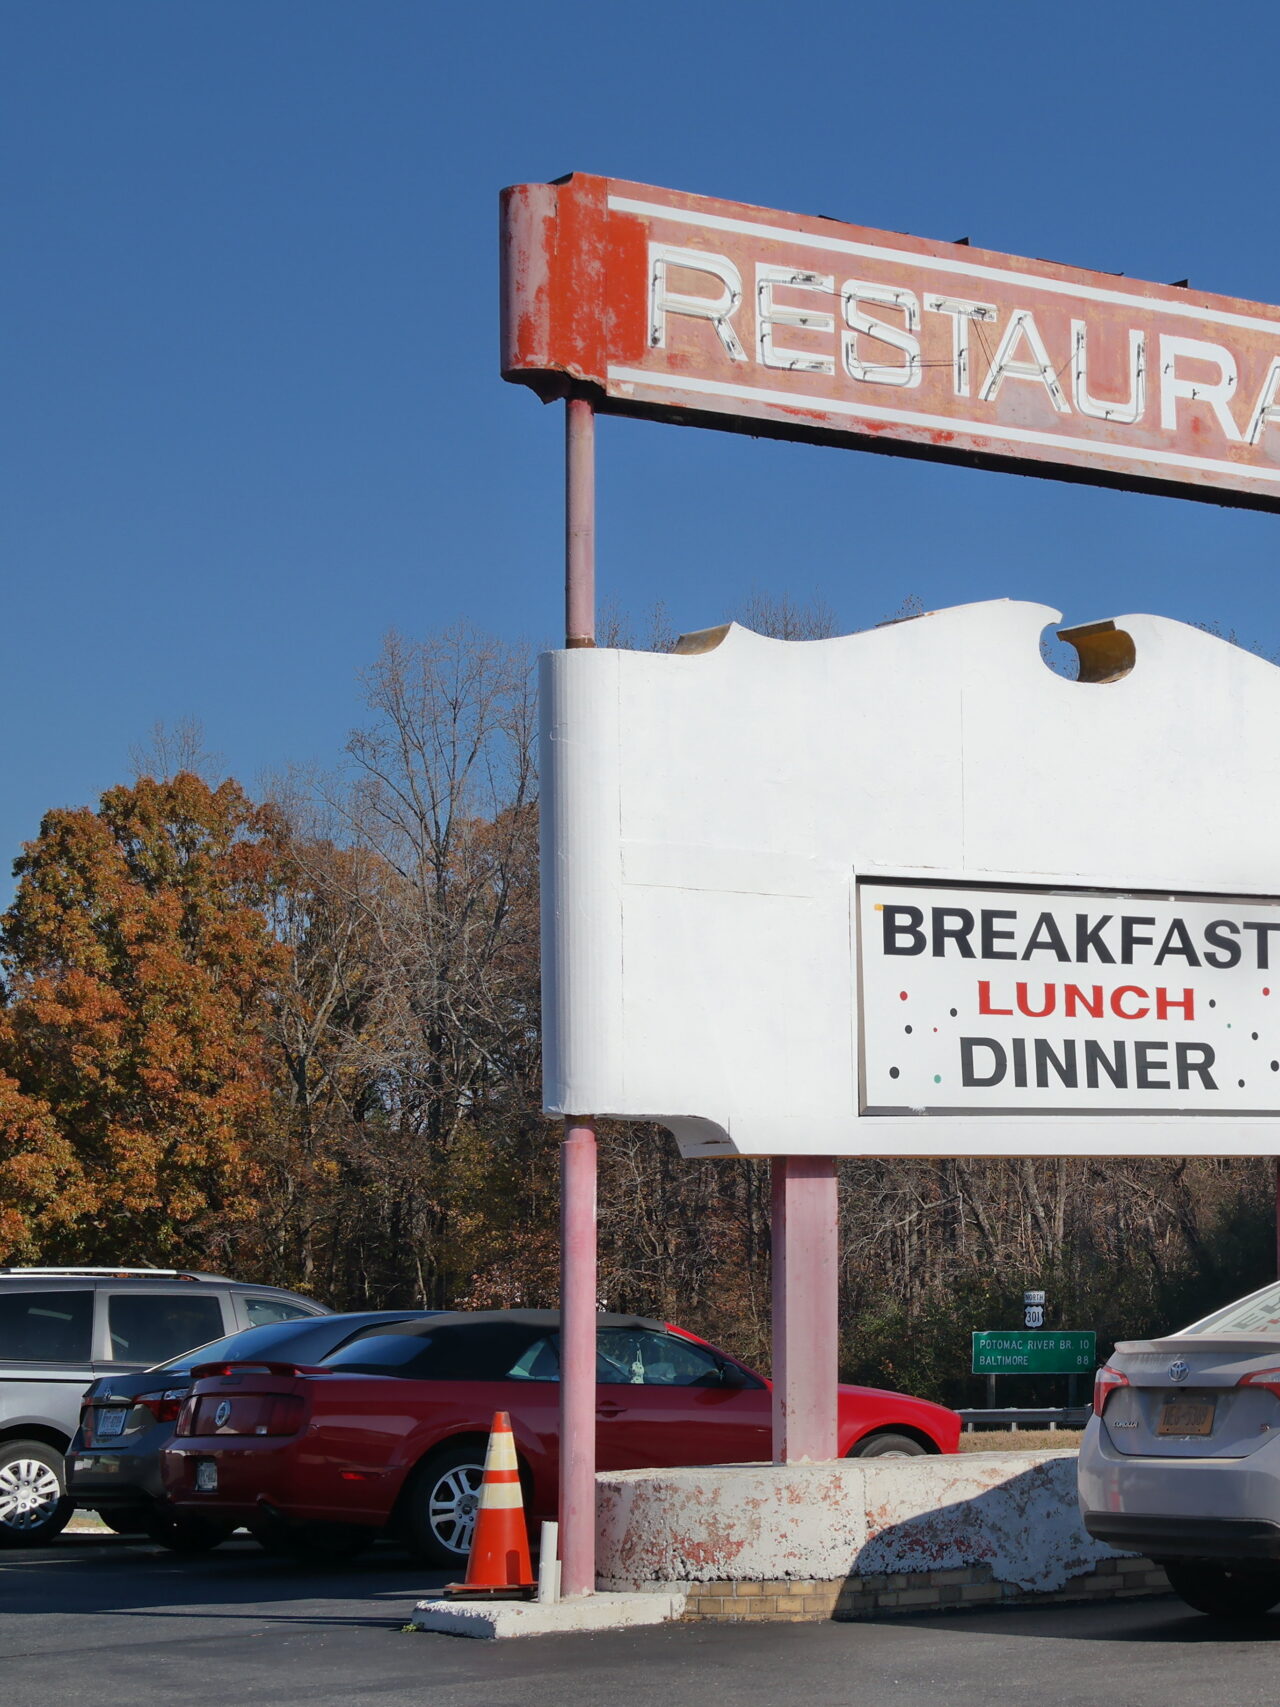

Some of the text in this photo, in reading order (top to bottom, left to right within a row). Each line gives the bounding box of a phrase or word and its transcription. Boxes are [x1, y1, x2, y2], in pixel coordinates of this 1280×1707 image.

[977, 980, 1196, 1021] LUNCH
[959, 1036, 1220, 1090] DINNER
[1024, 1292, 1044, 1301] NORTH
[1026, 1310, 1041, 1323] 301
[979, 1339, 1023, 1349] POTOMAC
[1027, 1339, 1055, 1349] RIVER
[1079, 1339, 1090, 1349] 10
[979, 1355, 1089, 1366] BALTIMORE 88
